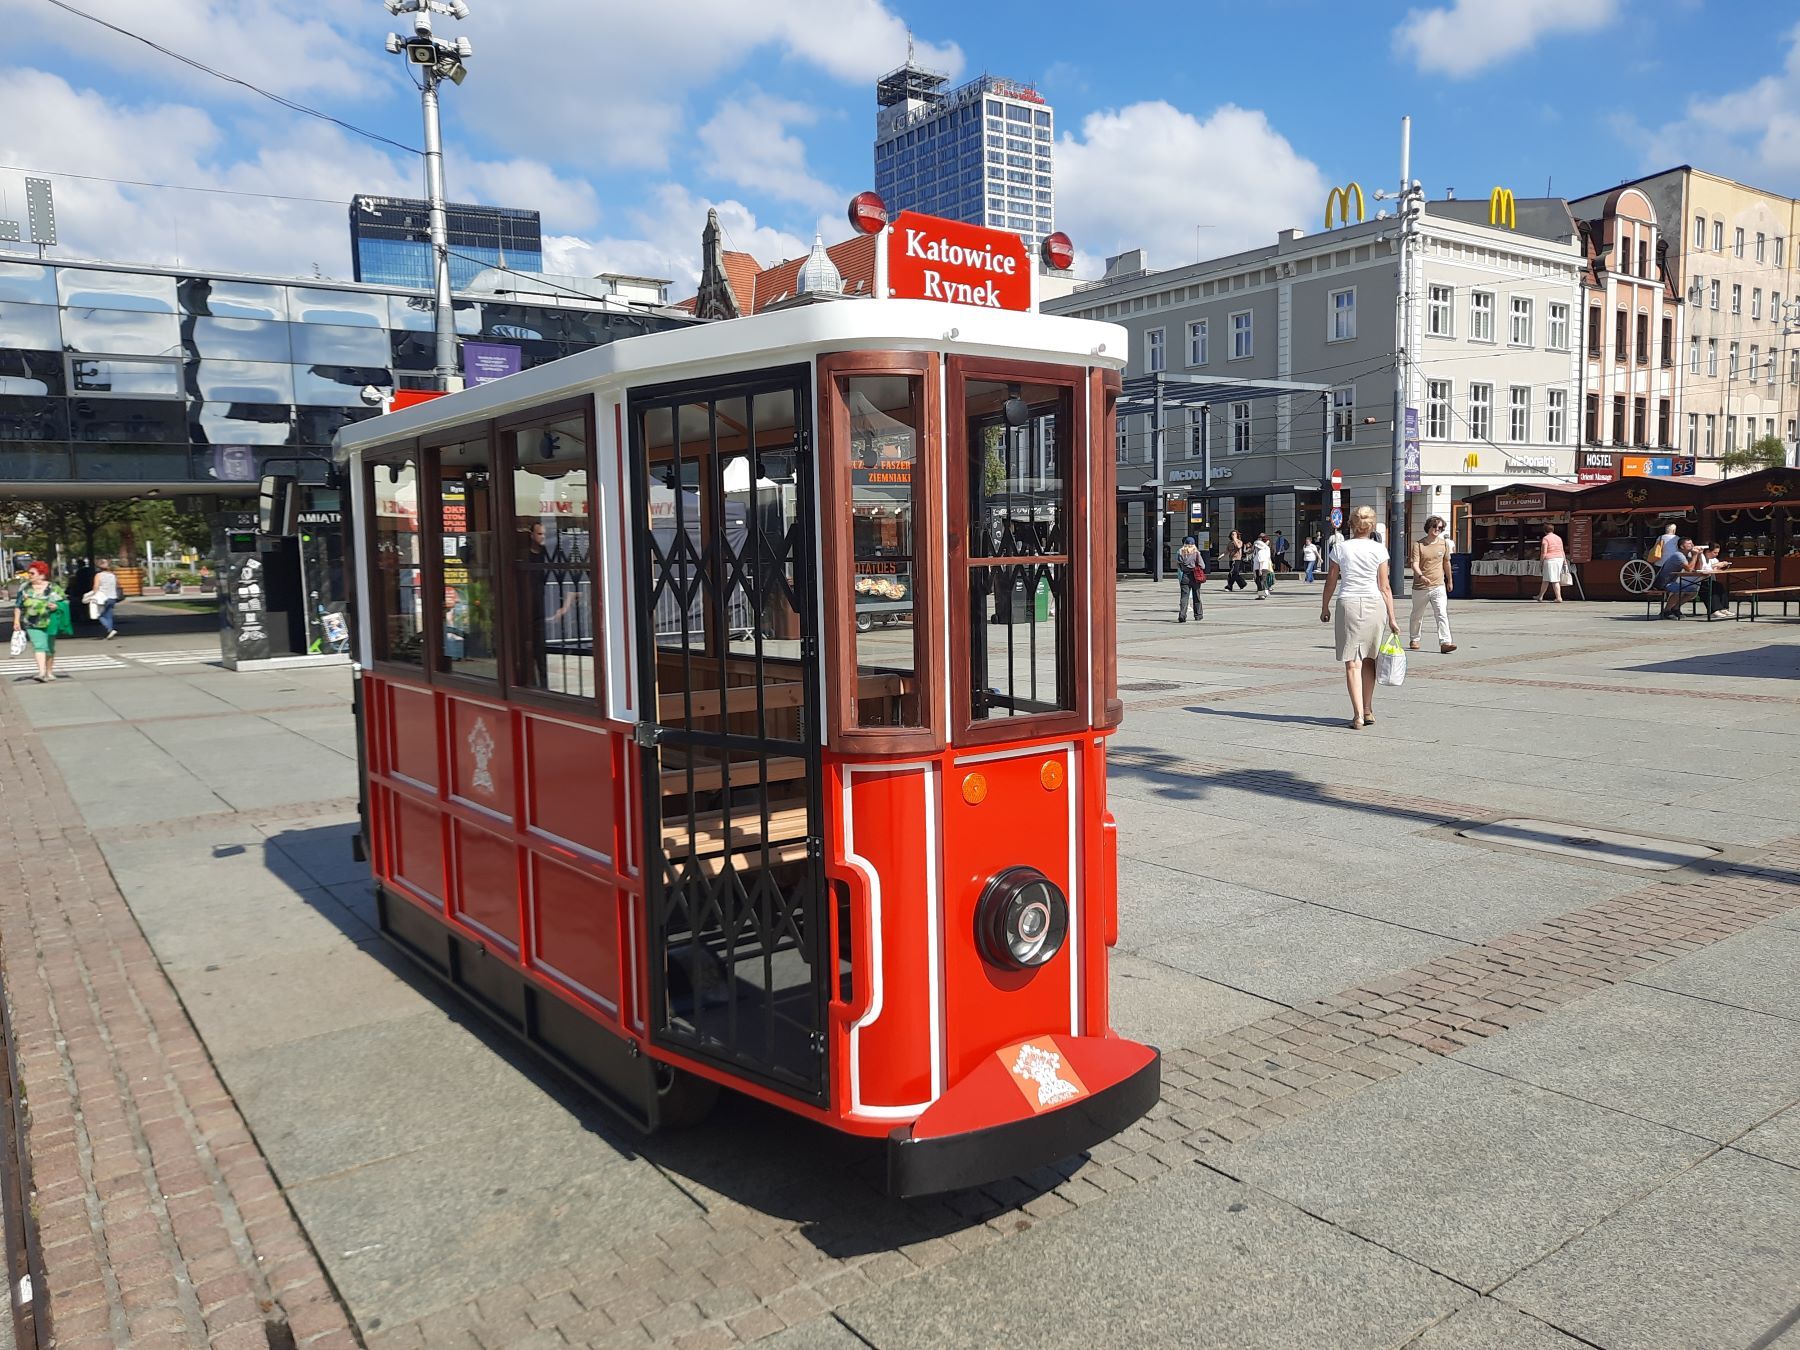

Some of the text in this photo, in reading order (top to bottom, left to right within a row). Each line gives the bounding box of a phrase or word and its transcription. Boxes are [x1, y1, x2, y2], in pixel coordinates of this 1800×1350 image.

[905, 228, 1016, 275] Katowice
[923, 270, 1001, 308] Rynek
[1586, 454, 1613, 467] HOSTEL
[1674, 460, 1693, 474] STS
[1168, 466, 1233, 482] McDold's
